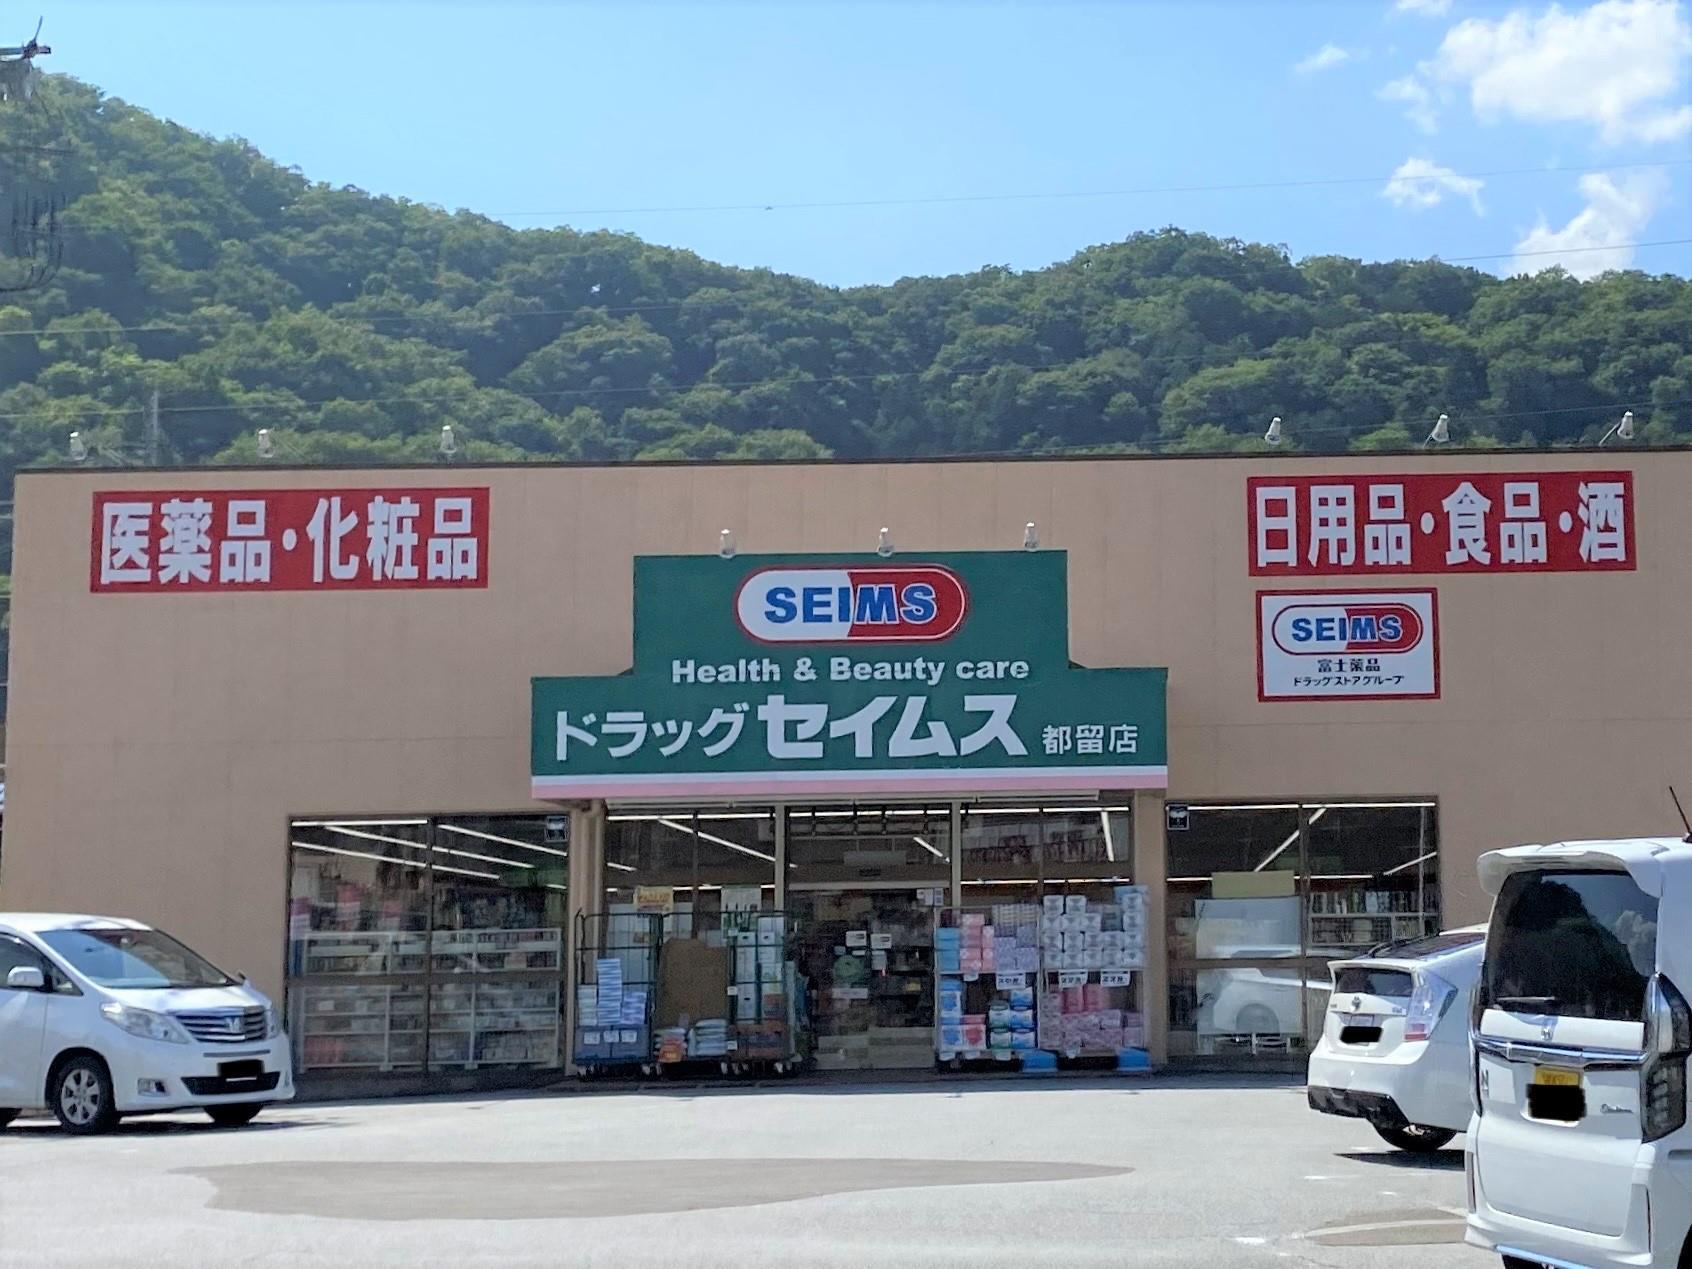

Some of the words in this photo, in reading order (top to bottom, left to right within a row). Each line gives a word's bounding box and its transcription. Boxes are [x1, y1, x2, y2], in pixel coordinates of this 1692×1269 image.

[100, 495, 478, 585] 医薬品・化粧品
[1255, 481, 1627, 568] 日用品・食品・酒
[764, 583, 938, 625] SEIMS
[1291, 615, 1404, 642] SEIMS
[672, 658, 781, 685] Health
[793, 656, 818, 681] &
[830, 656, 946, 685] Beauty
[955, 657, 1030, 680] care
[1317, 657, 1381, 673] 富士薬品
[1041, 723, 1138, 755] 都留店
